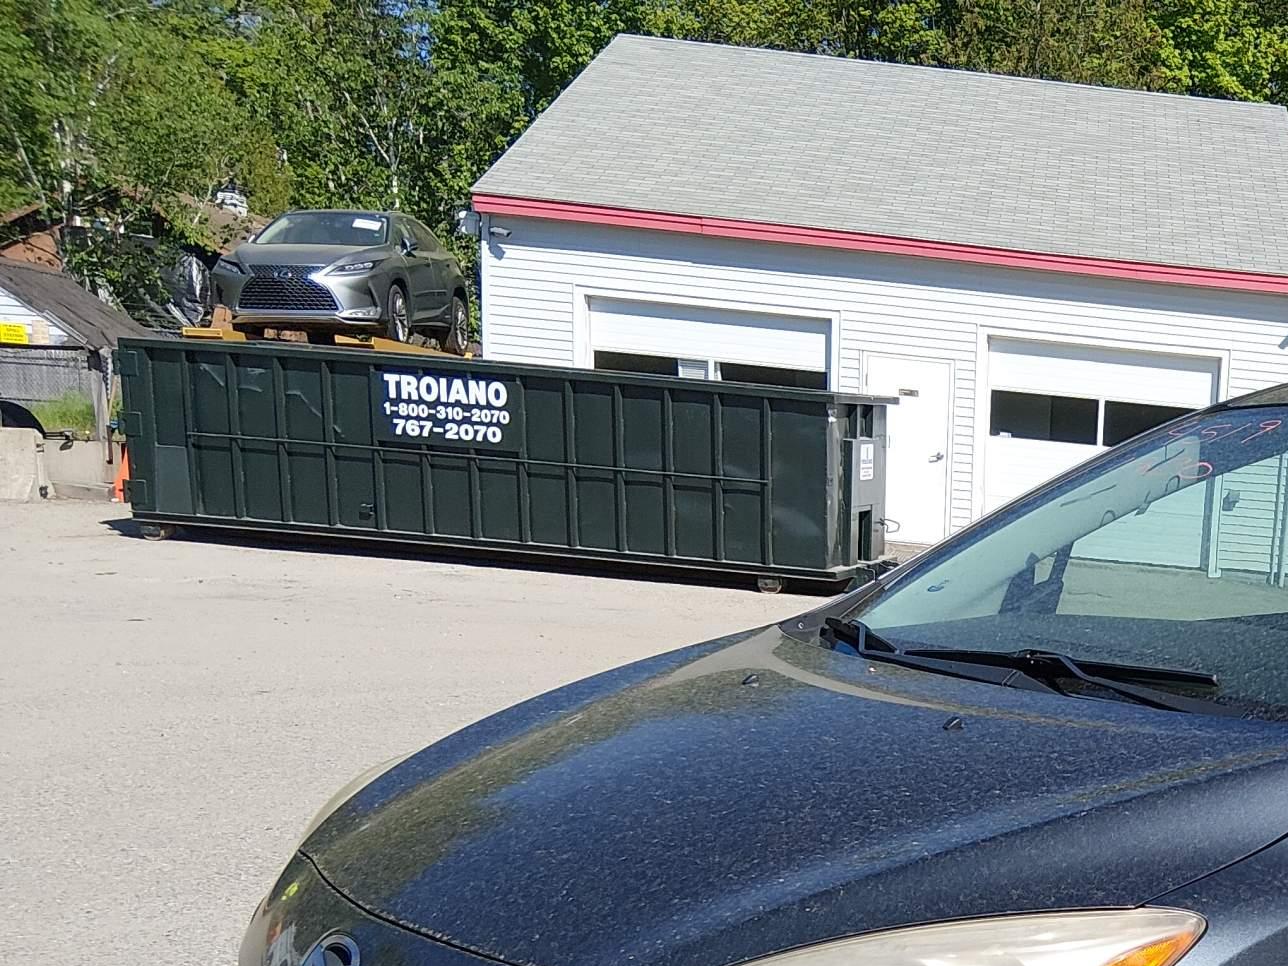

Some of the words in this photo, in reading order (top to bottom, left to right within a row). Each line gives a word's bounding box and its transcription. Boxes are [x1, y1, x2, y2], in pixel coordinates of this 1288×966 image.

[383, 373, 508, 407] TROIANO
[383, 402, 510, 424] 1-800-310-2070
[393, 419, 502, 443] 767-2070
